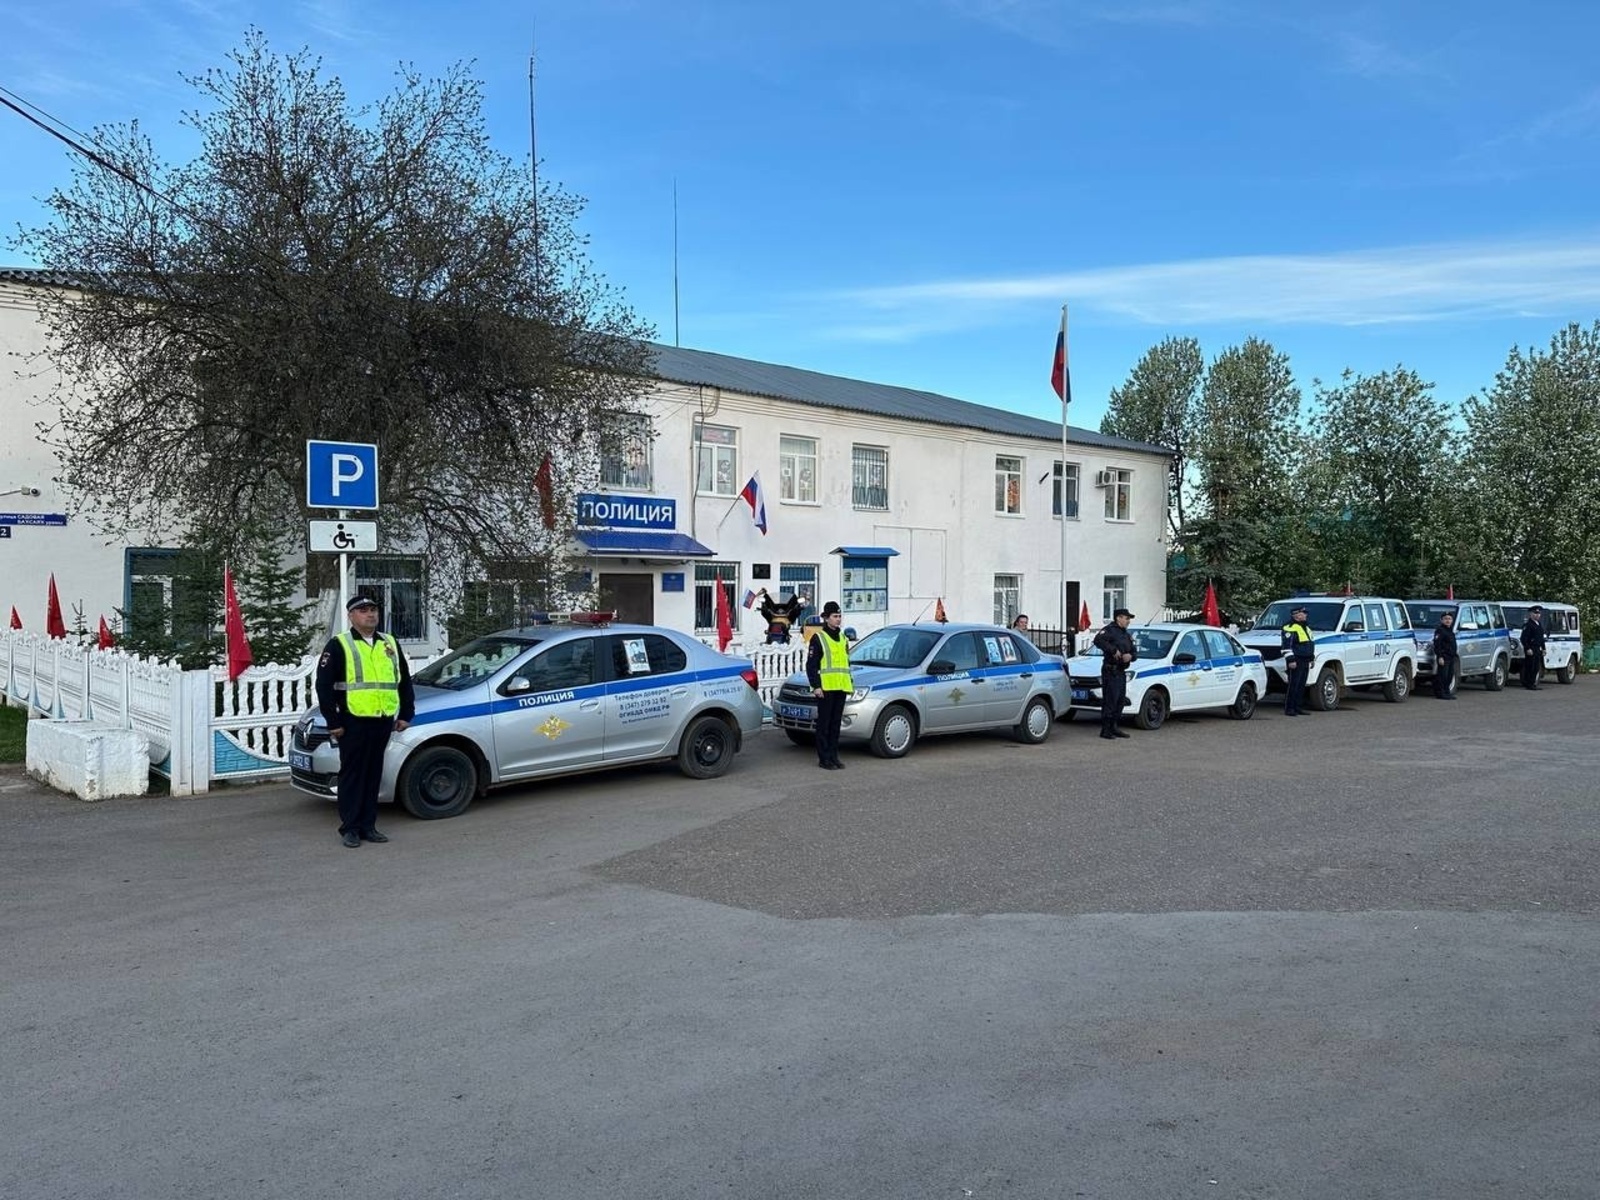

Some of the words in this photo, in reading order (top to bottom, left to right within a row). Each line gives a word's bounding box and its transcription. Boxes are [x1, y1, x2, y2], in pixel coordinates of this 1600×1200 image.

[332, 453, 364, 497] P
[581, 501, 673, 525] ПОЛИЦИЯ
[1374, 643, 1391, 657] ДПС
[519, 691, 575, 708] ПОЛИЦИЯ
[614, 693, 643, 702] Телефон
[643, 688, 670, 698] доверия
